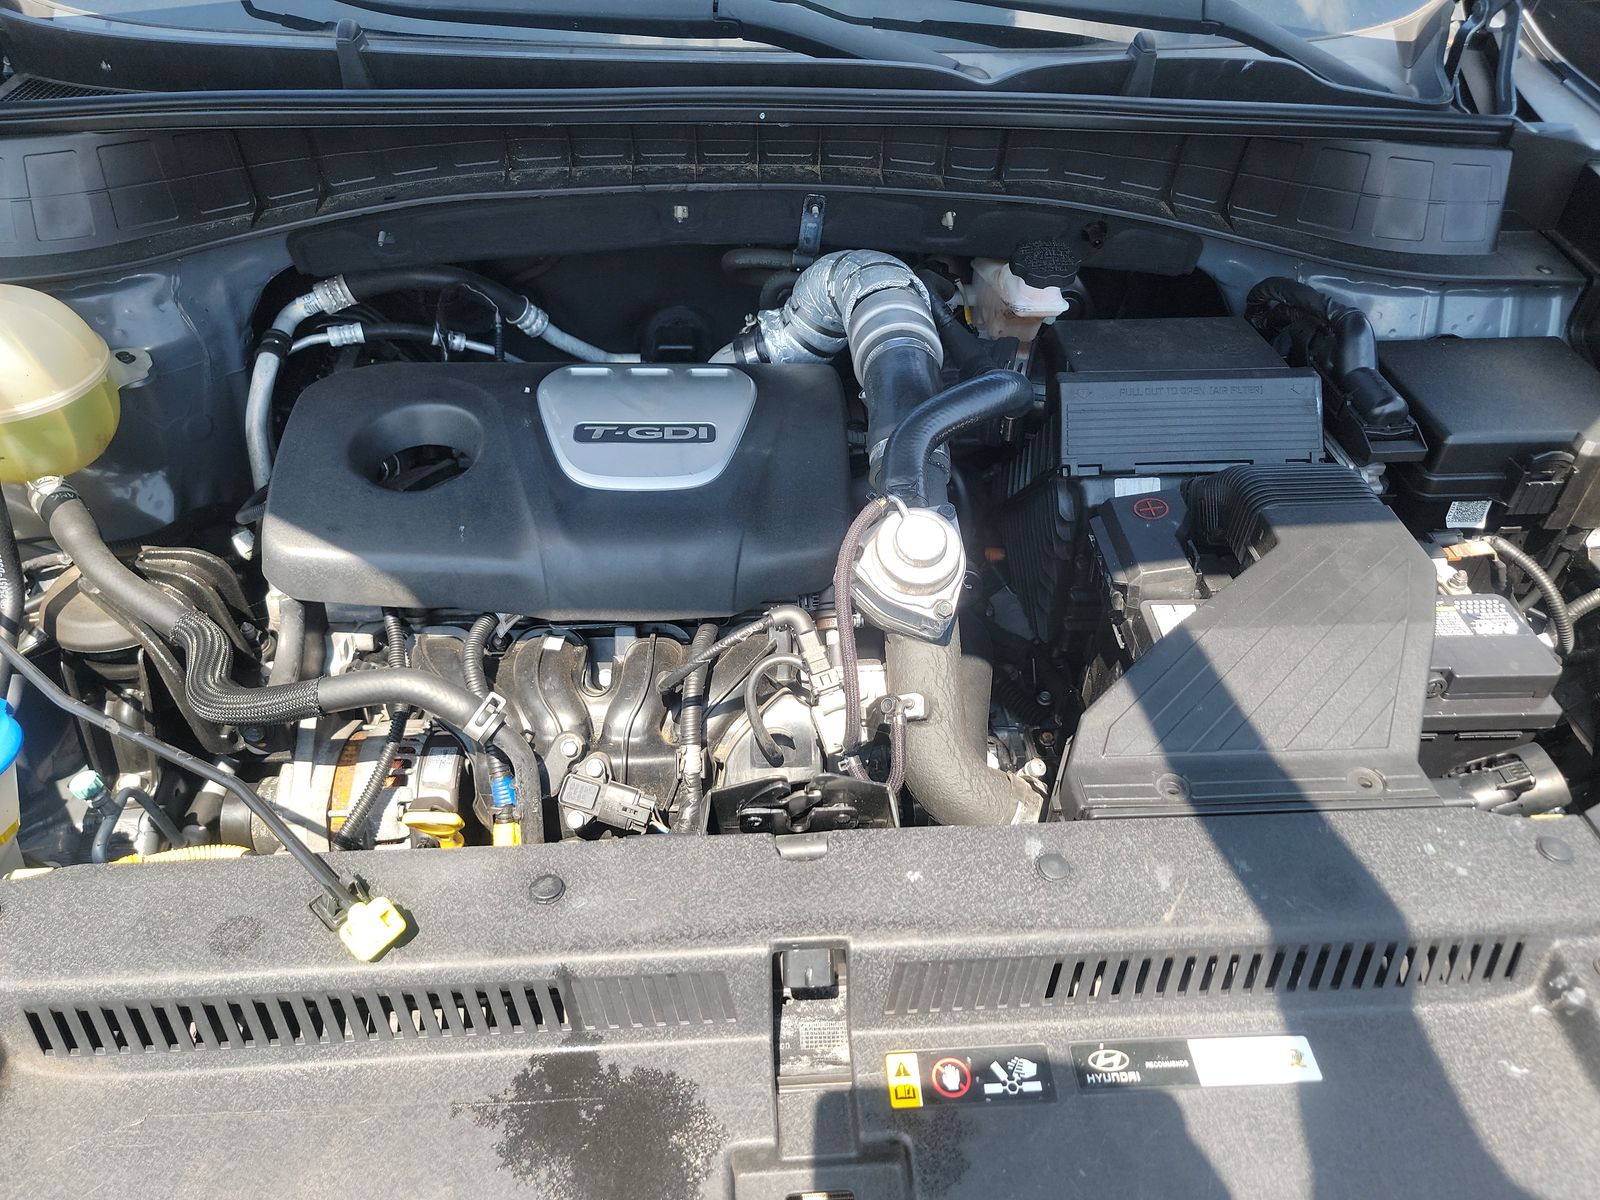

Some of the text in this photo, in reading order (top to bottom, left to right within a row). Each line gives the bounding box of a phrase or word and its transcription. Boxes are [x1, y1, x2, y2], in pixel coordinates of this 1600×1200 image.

[1119, 386, 1144, 397] PULL
[1144, 386, 1164, 396] OUT
[1166, 386, 1179, 396] TO
[1180, 386, 1206, 396] OPEN
[583, 425, 708, 440] T-GDI
[1086, 1070, 1141, 1084] HYUNDAI
